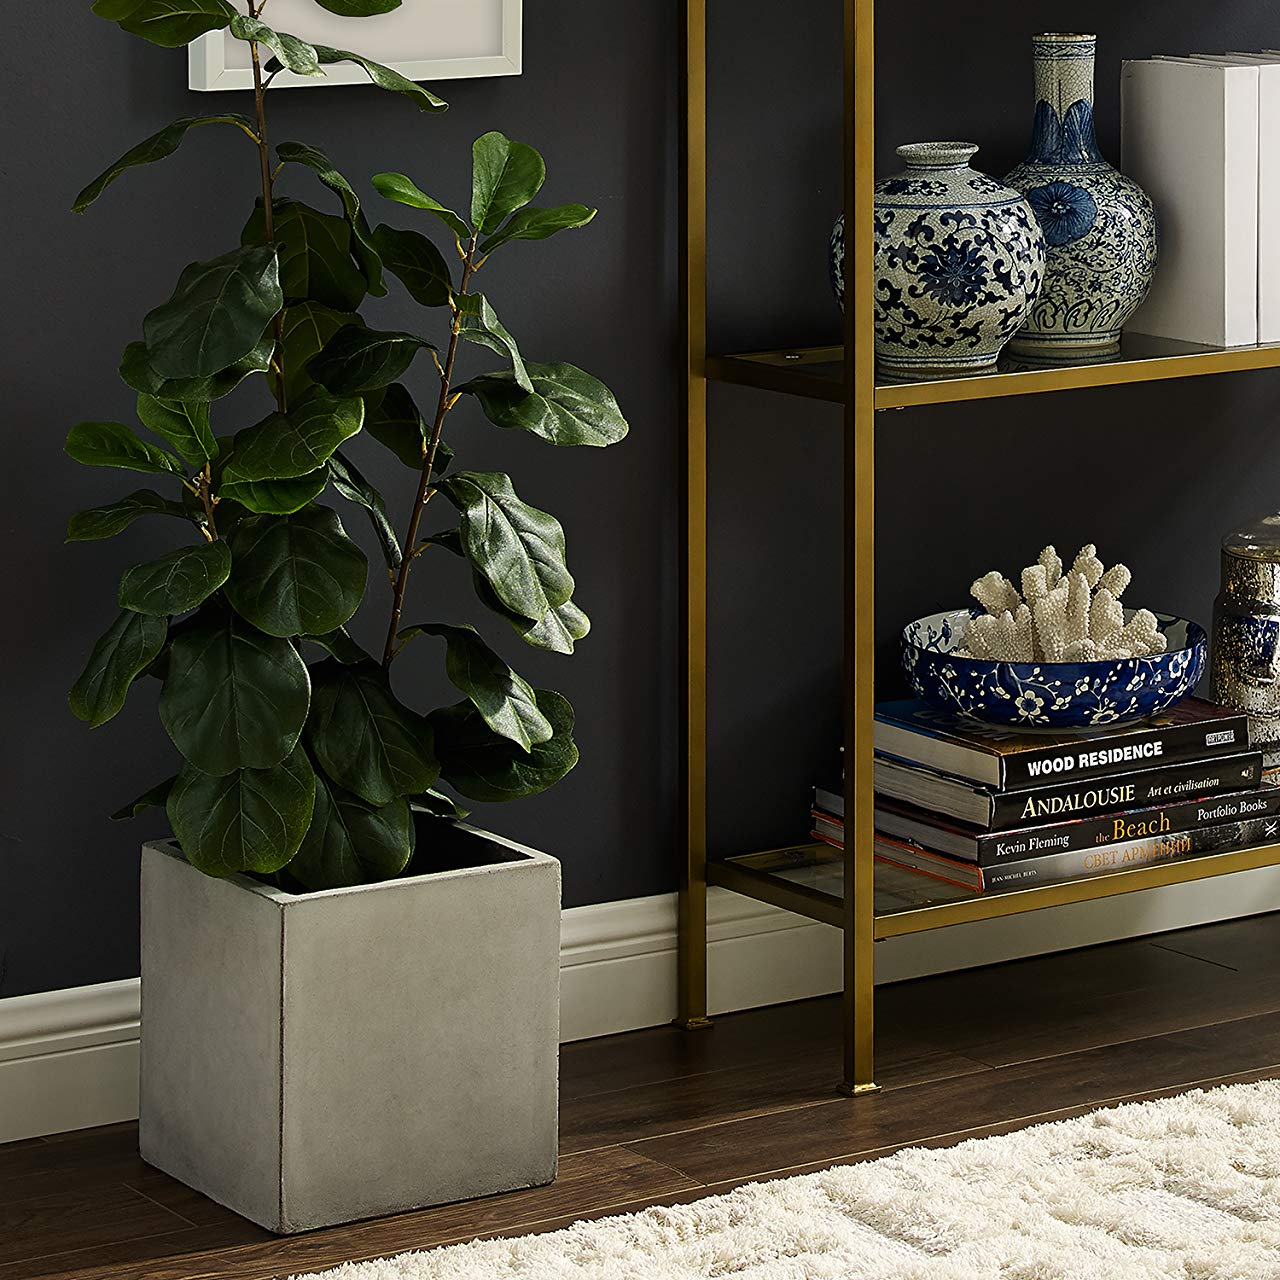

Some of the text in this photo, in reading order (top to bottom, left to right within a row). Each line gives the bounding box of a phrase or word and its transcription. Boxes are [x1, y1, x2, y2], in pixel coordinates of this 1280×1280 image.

[1027, 741, 1163, 777] WOOD RESIDENCE
[1021, 776, 1220, 819] ANDALOUSIE Art et civilisation
[1197, 798, 1268, 822] Portfolio Books
[1095, 812, 1171, 844] the Beach
[996, 833, 1070, 857] Kevin Fleming
[1083, 850, 1118, 869] СВЕТ
